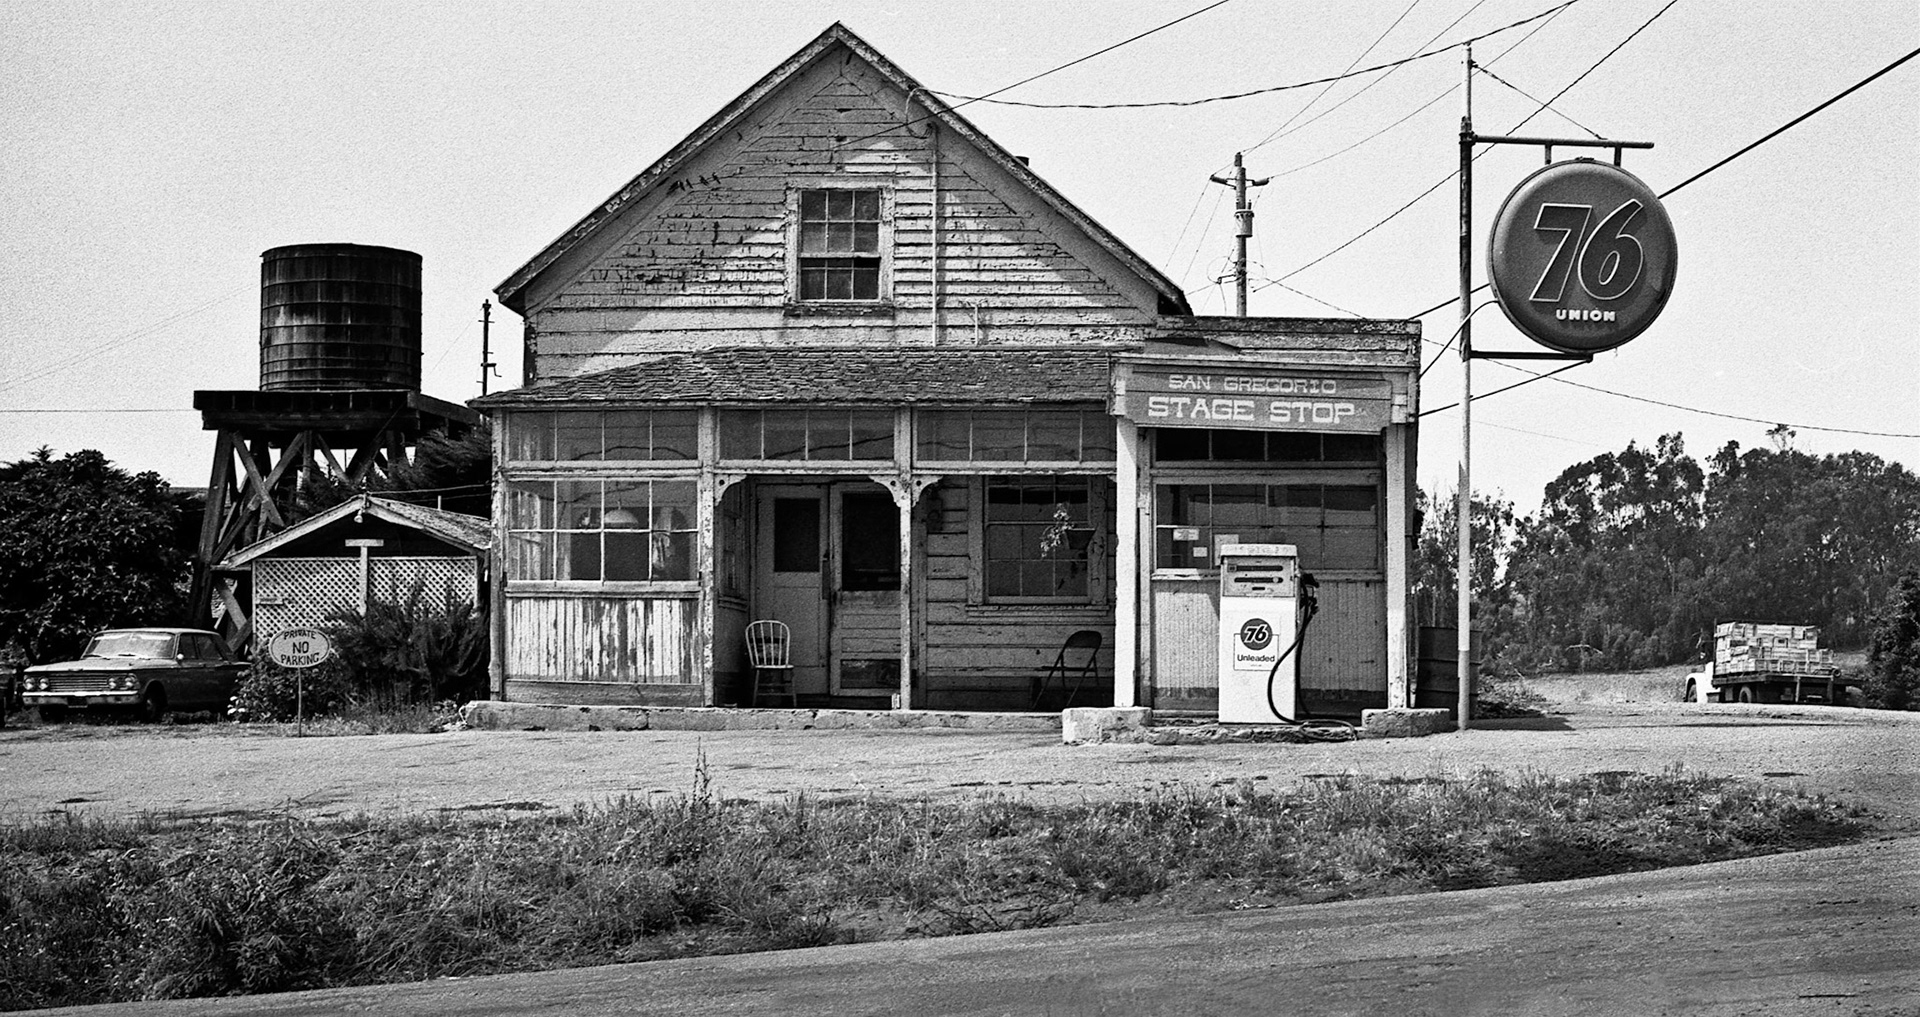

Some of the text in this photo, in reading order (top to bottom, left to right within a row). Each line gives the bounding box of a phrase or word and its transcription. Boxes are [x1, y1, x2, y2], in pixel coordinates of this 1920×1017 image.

[1529, 198, 1643, 302] 76
[1556, 309, 1616, 322] UNION
[1168, 374, 1337, 394] SAN GREGORIO
[1148, 396, 1355, 424] STAGE STOP
[283, 629, 317, 640] PRIVATE
[1244, 624, 1269, 643] 76
[293, 641, 309, 654] NO
[281, 652, 320, 666] PARKING
[1237, 654, 1275, 662] Unleaded
